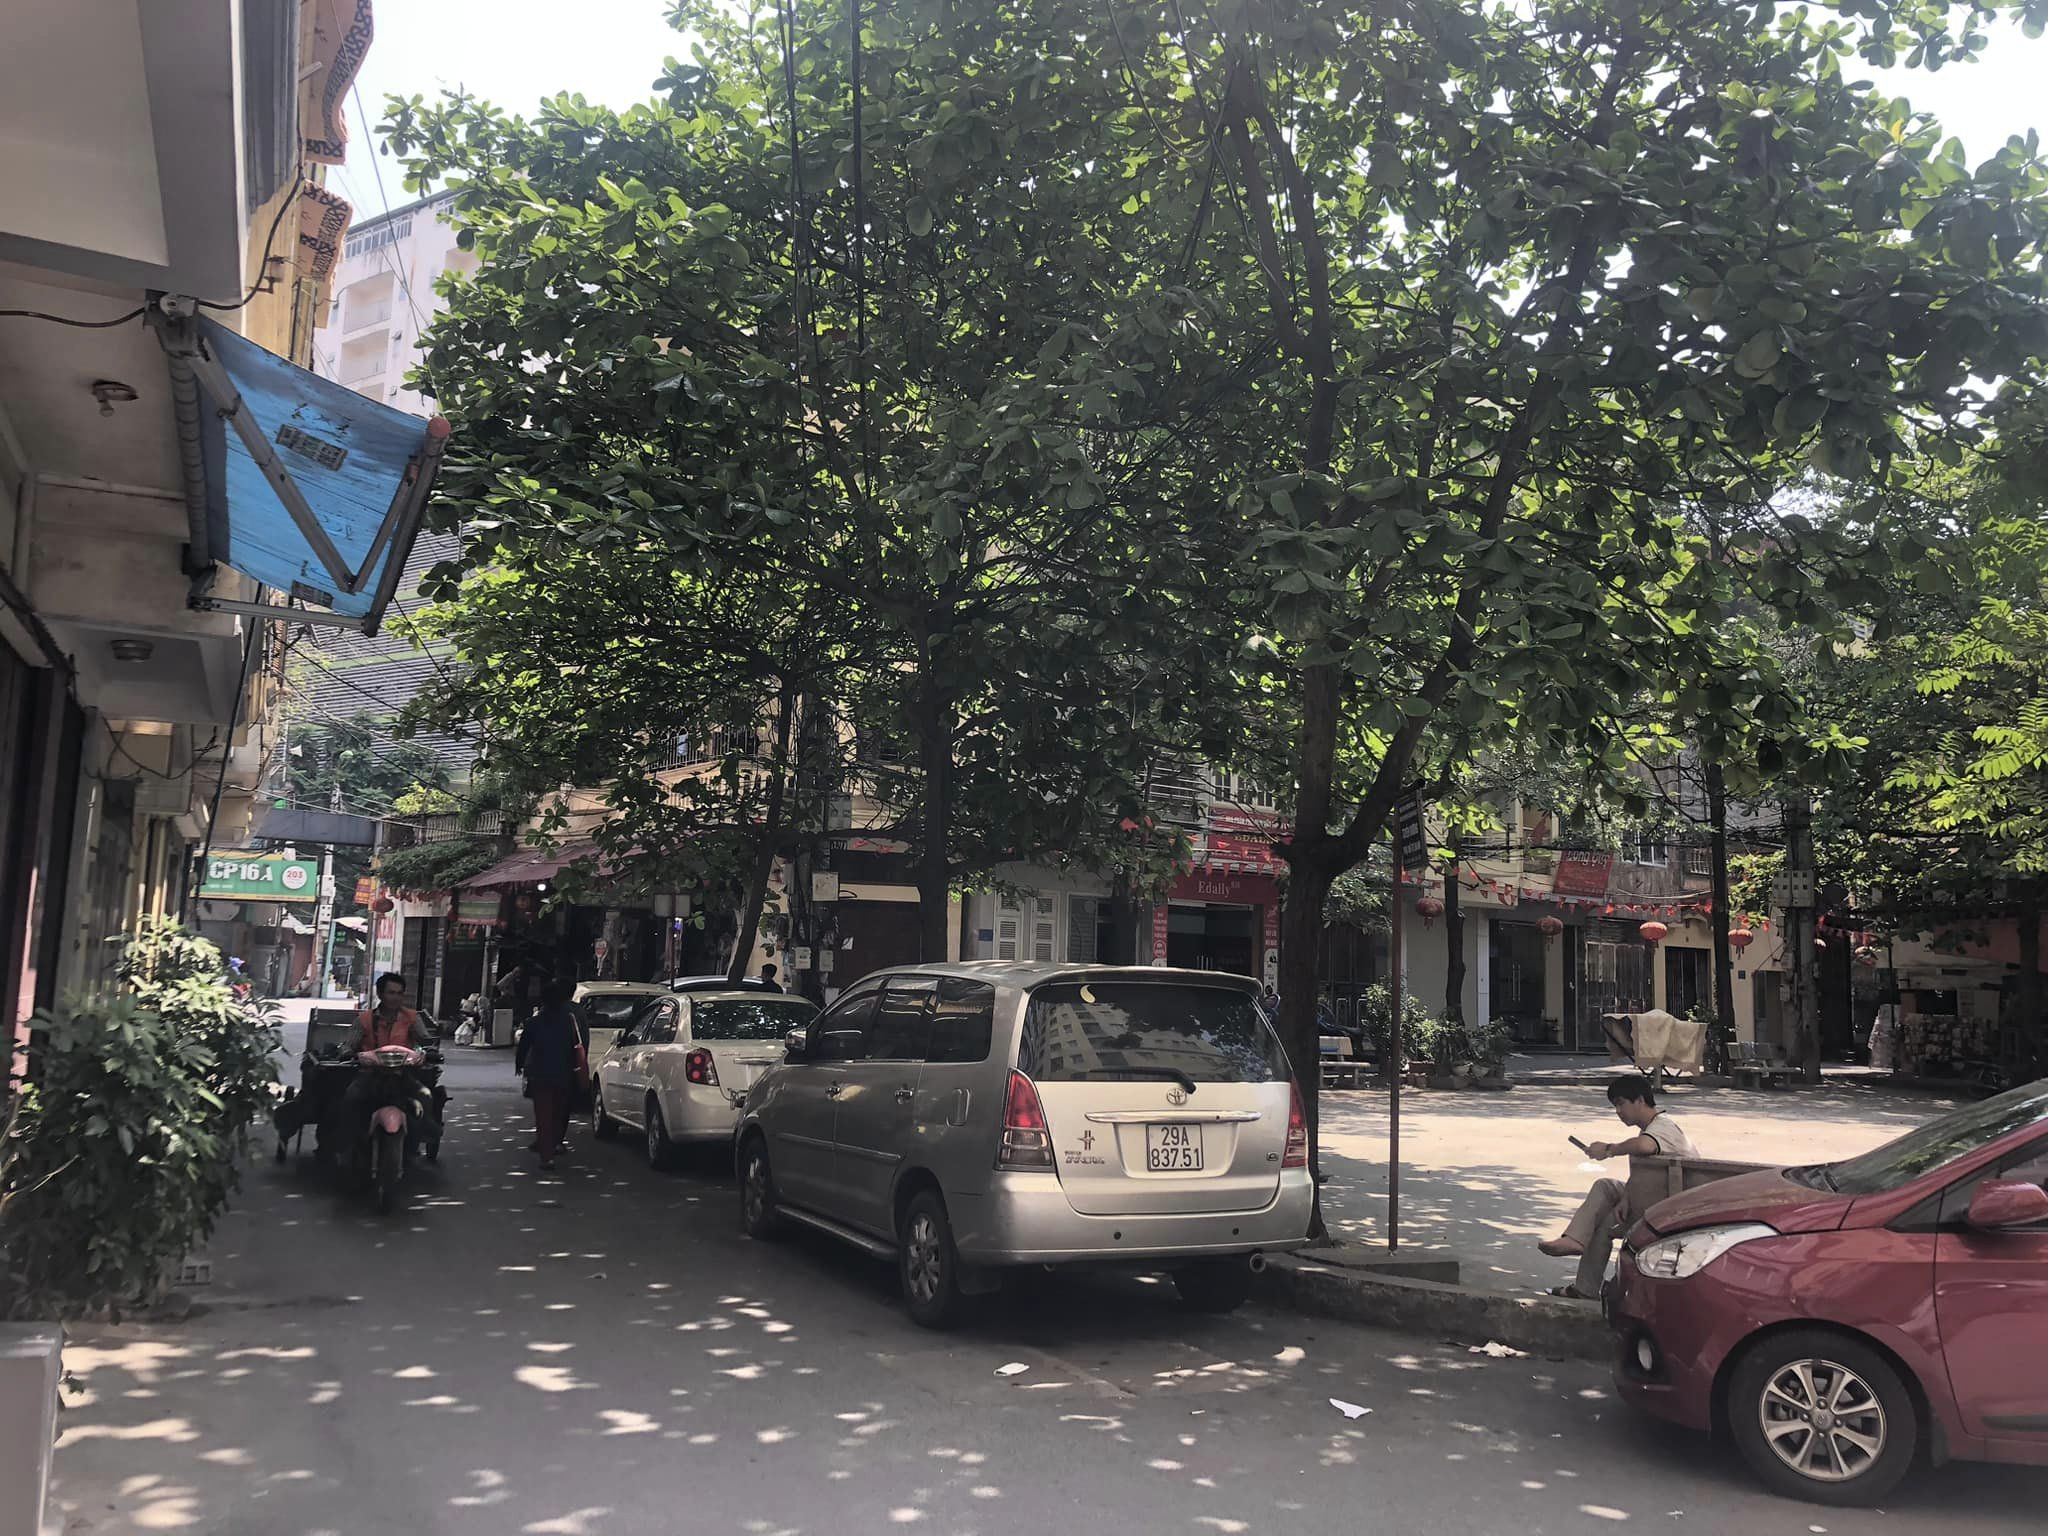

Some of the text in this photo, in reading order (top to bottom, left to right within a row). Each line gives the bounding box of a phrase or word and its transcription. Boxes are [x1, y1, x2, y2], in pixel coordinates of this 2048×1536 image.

[1198, 880, 1230, 898] Edally
[1161, 1127, 1189, 1146] 29A
[1151, 1148, 1200, 1168] 837.51
